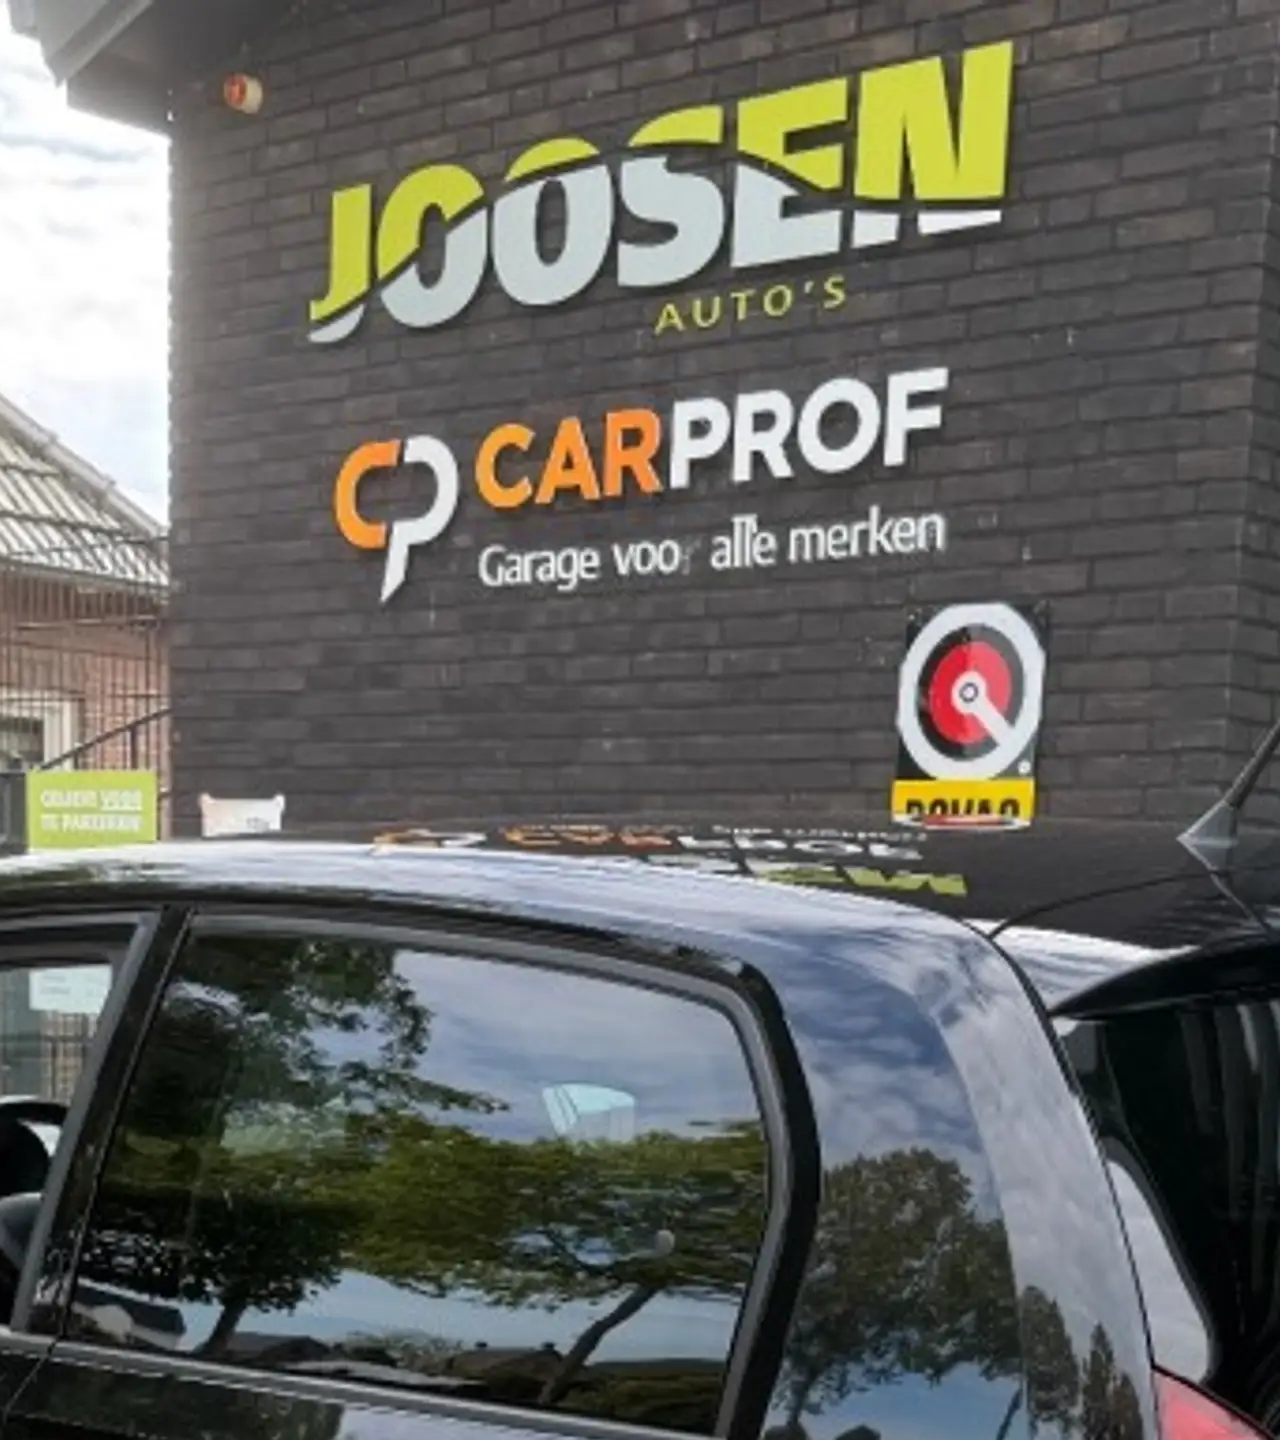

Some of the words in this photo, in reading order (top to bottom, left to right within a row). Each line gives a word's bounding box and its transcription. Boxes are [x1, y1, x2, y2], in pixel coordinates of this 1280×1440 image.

[308, 41, 1013, 343] JOOSEN
[654, 276, 848, 336] AUTO'S
[474, 367, 949, 508] CARPROF
[478, 544, 601, 591] Garage
[611, 538, 698, 577] voo
[710, 512, 777, 569] alle
[787, 504, 947, 564] merken
